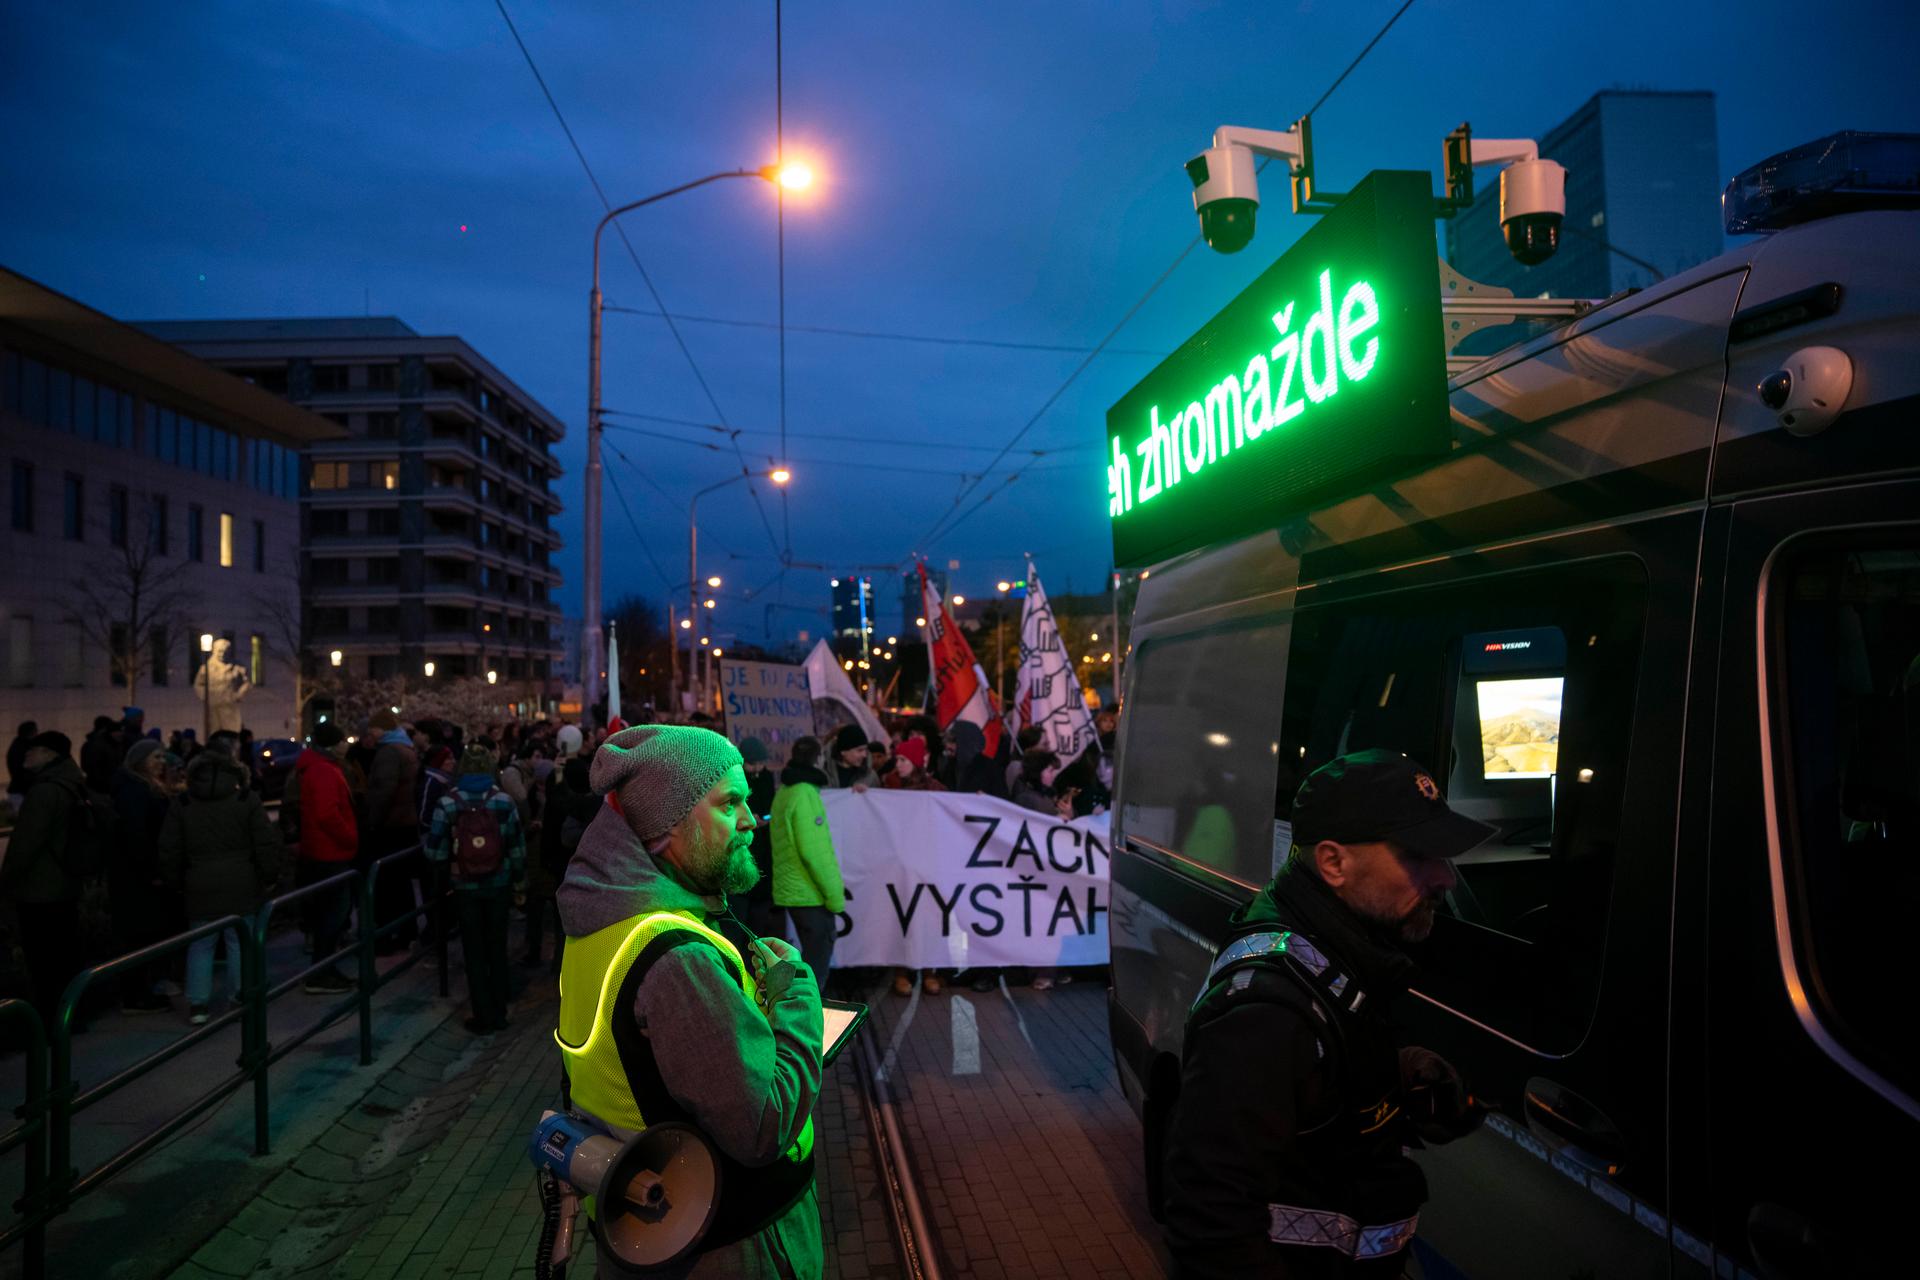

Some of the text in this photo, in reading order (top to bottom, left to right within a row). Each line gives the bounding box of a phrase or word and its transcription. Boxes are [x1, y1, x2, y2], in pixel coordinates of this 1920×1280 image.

[1137, 267, 1379, 504] zhromažde
[1484, 641, 1531, 652] HIKVISION
[723, 667, 749, 687] JE
